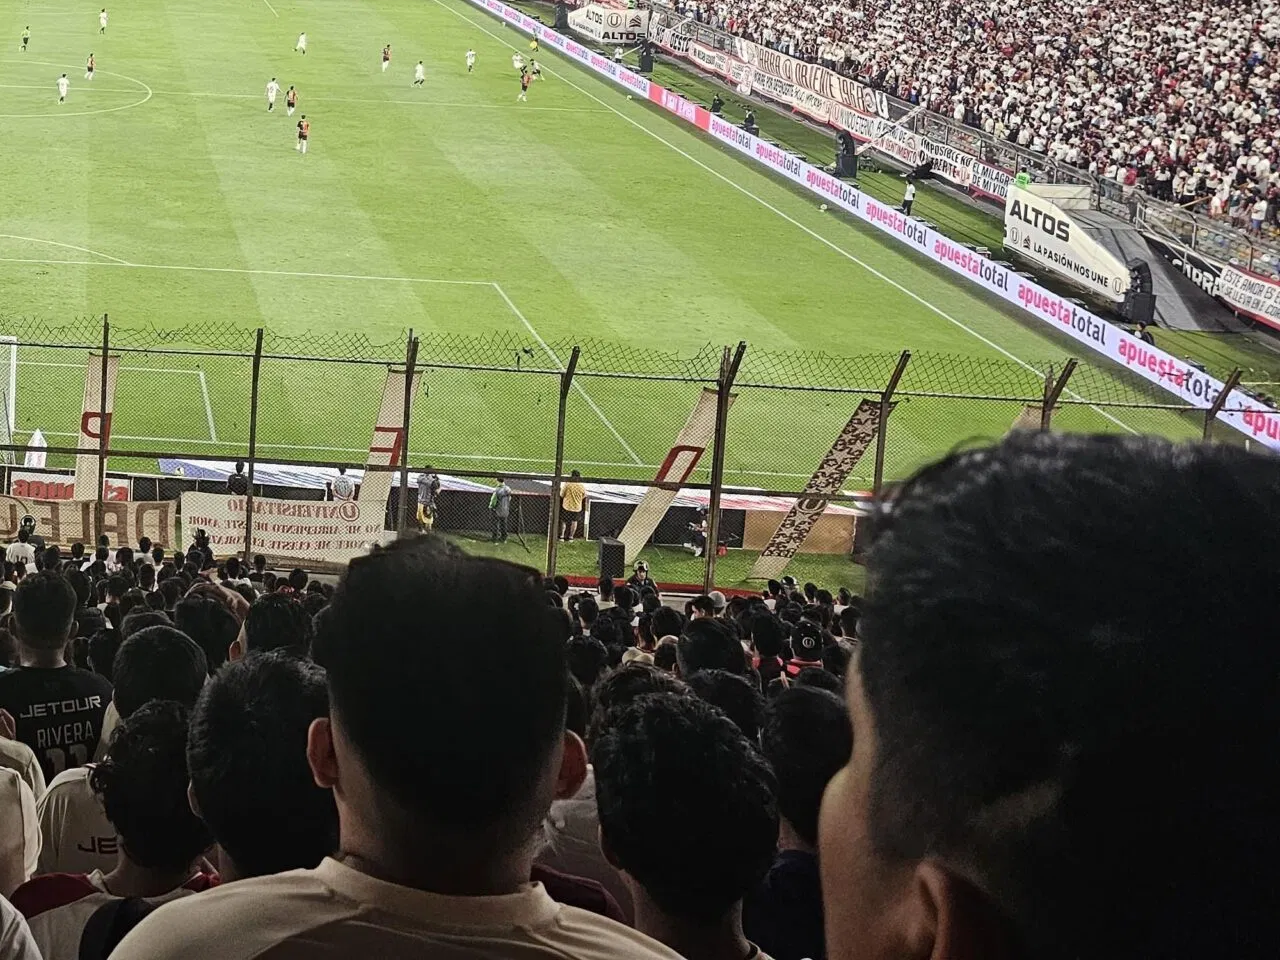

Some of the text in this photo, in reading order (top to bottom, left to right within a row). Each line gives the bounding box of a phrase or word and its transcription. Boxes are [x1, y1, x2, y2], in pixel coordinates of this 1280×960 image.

[712, 119, 751, 150] apuestatotal
[756, 142, 801, 181] apuestatotal
[806, 169, 860, 209] apuestatotal
[866, 202, 927, 247] apuestatotal
[1009, 200, 1070, 243] ALTOS
[935, 240, 1008, 291] apuestatotal
[1034, 243, 1042, 254] LA
[1043, 248, 1073, 269] PASIÓN
[1074, 262, 1090, 279] NOS
[1091, 272, 1109, 288] UNE
[1018, 283, 1106, 346] apuestatotal
[1118, 337, 1221, 403] apuestatota
[19, 695, 102, 719] JETOUR
[36, 720, 95, 749] RIVERA
